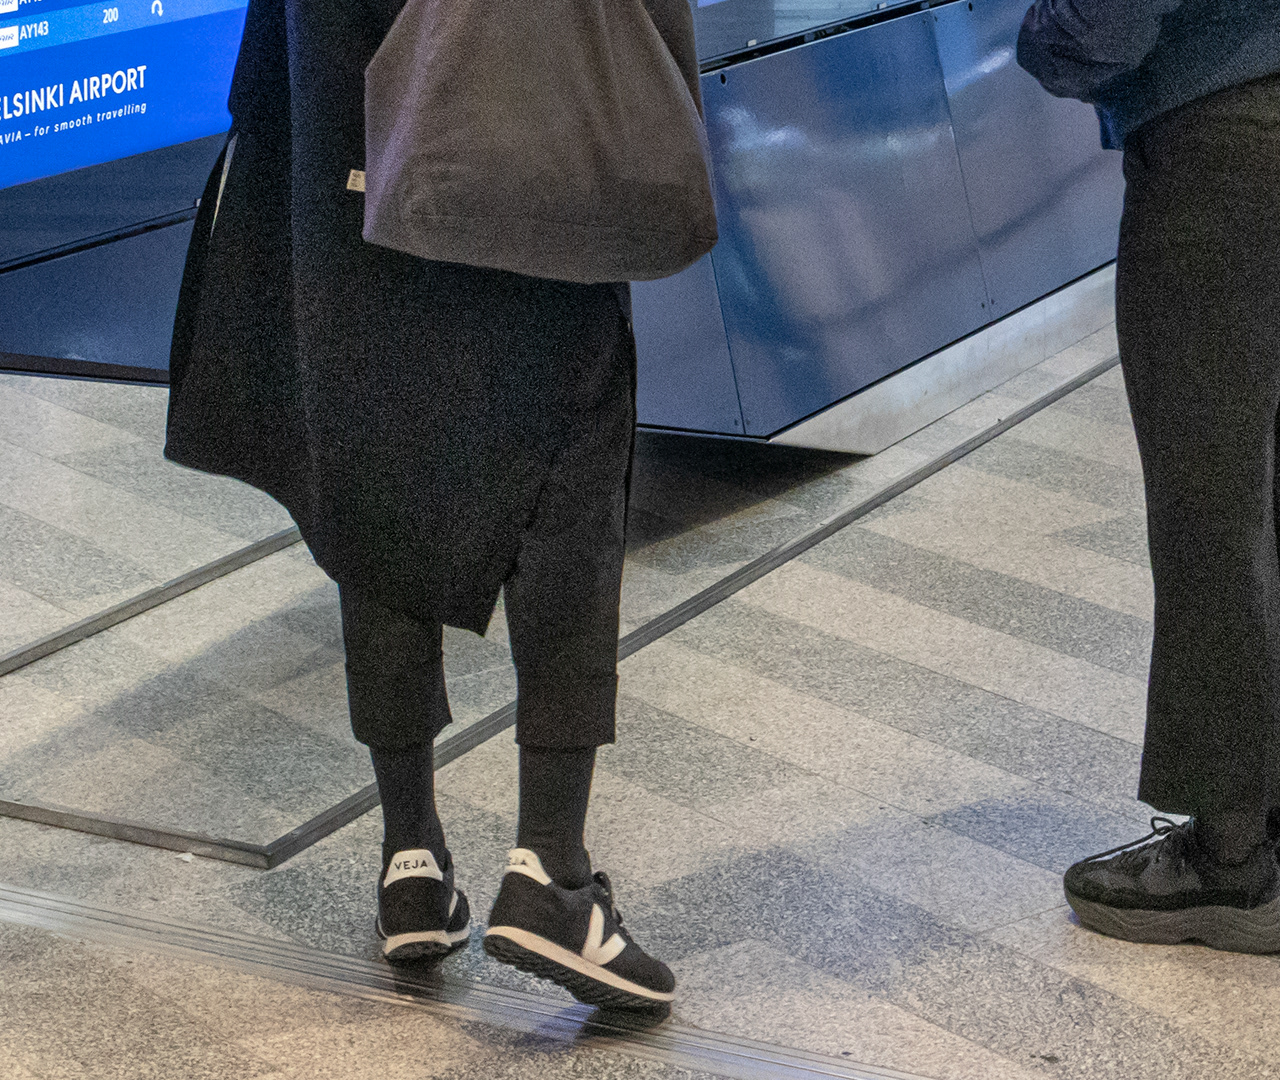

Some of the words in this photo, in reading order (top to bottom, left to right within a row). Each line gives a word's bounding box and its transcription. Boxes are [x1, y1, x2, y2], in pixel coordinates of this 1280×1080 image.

[19, 21, 48, 40] AY143
[70, 66, 147, 105] AIRPORT
[34, 123, 51, 139] for
[54, 114, 93, 133] smooth
[96, 101, 147, 123] travelling
[394, 859, 428, 870] VEJA
